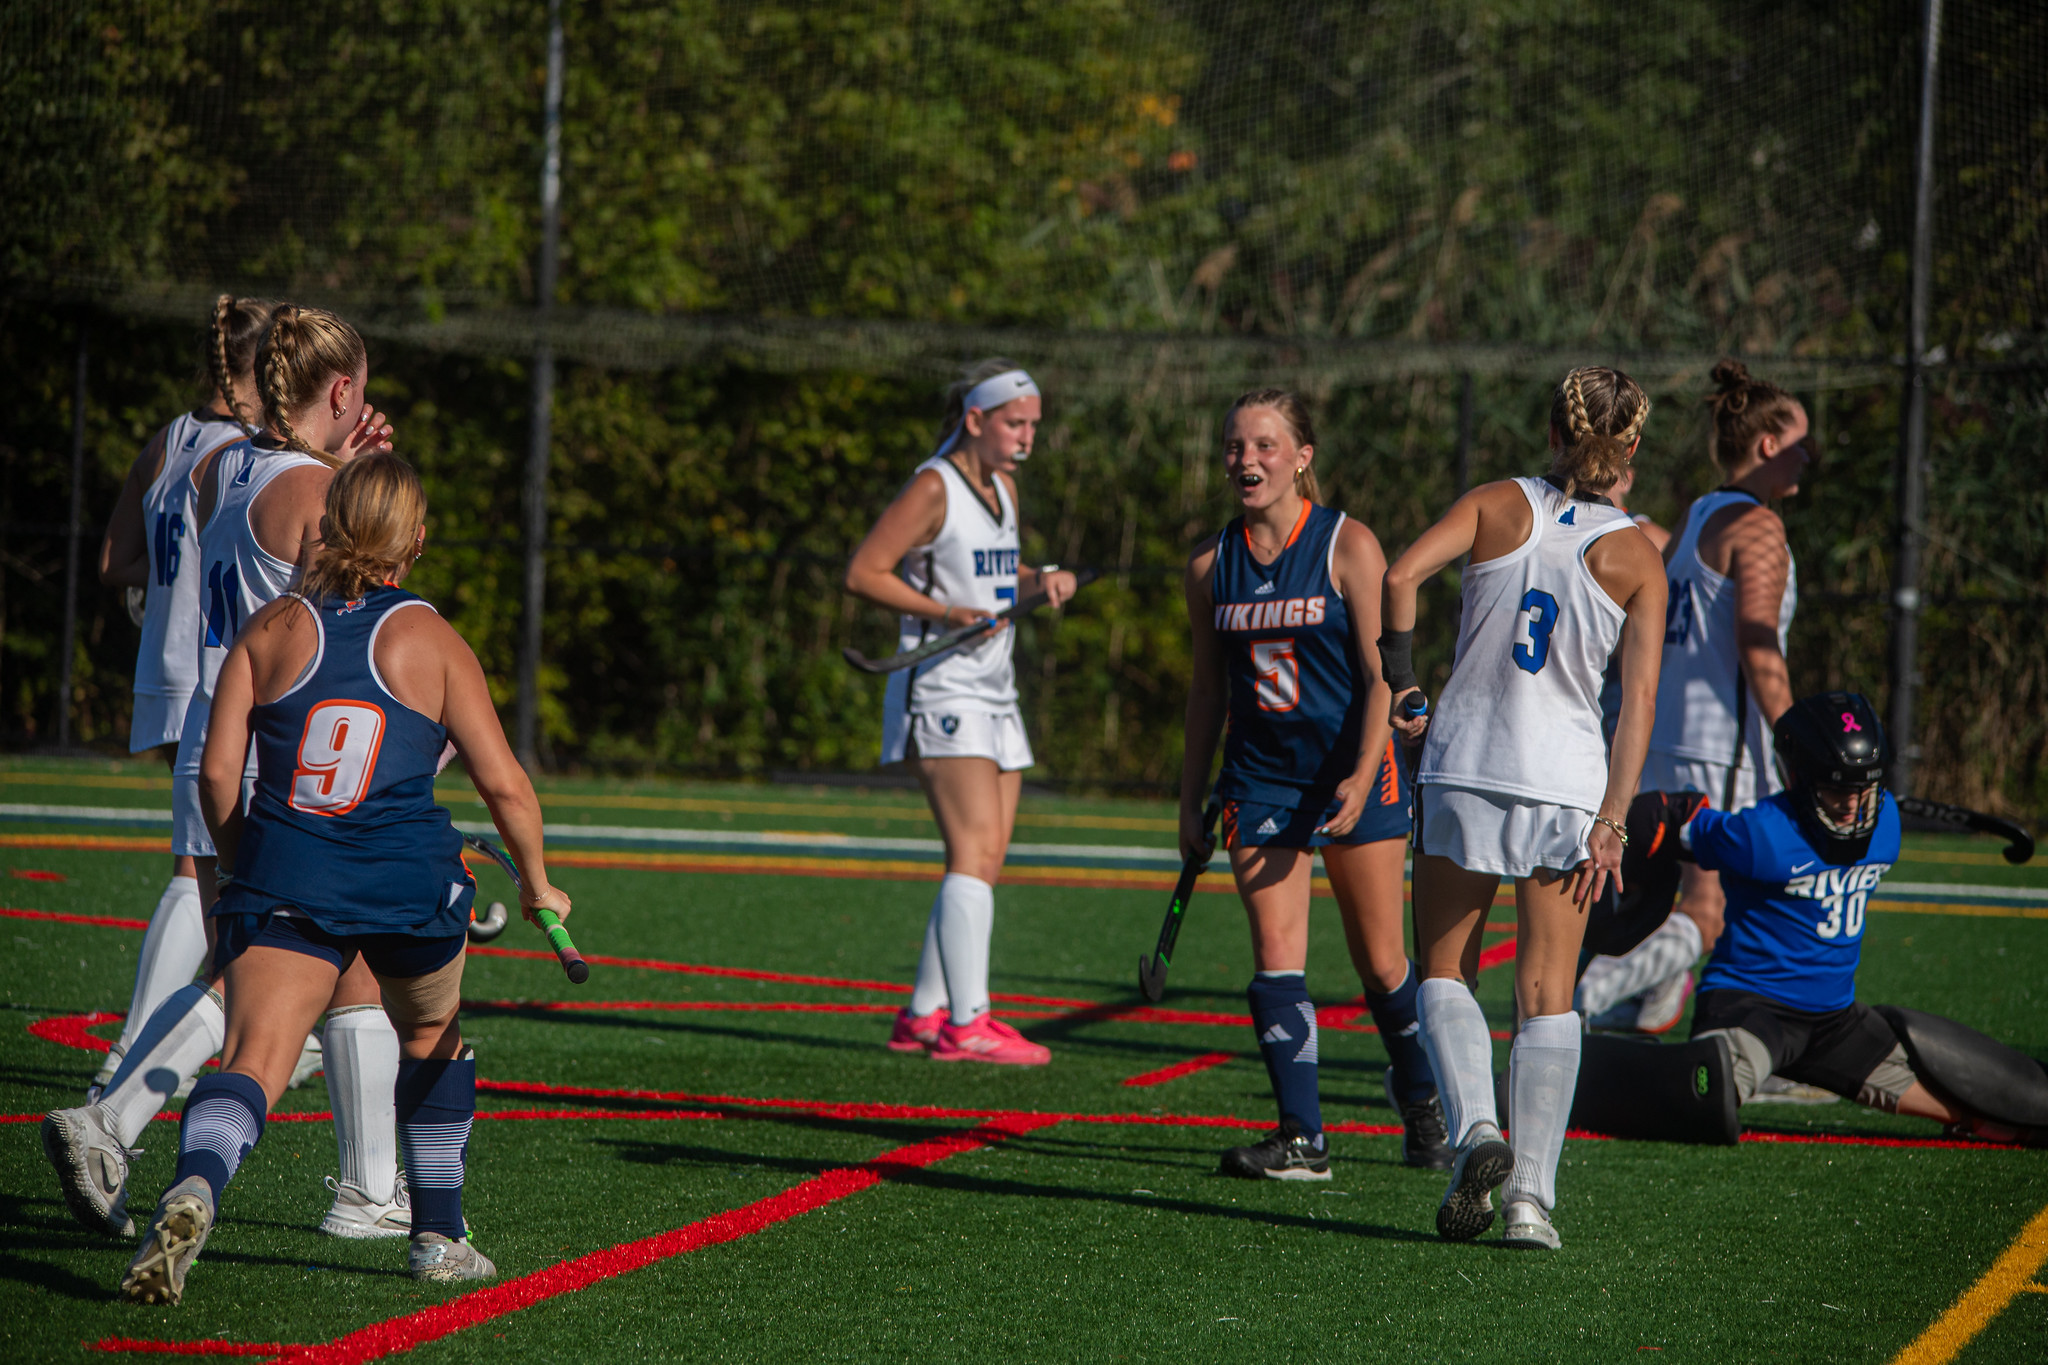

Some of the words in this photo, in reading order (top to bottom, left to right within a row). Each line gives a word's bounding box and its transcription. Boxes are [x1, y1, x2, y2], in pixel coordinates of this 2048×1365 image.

[154, 512, 187, 587] 16
[204, 560, 239, 648] 11
[1214, 595, 1326, 631] VIKINGS
[1512, 587, 1560, 675] 3
[1250, 637, 1299, 712] 5
[287, 698, 387, 817] 9
[1815, 890, 1868, 940] 30
